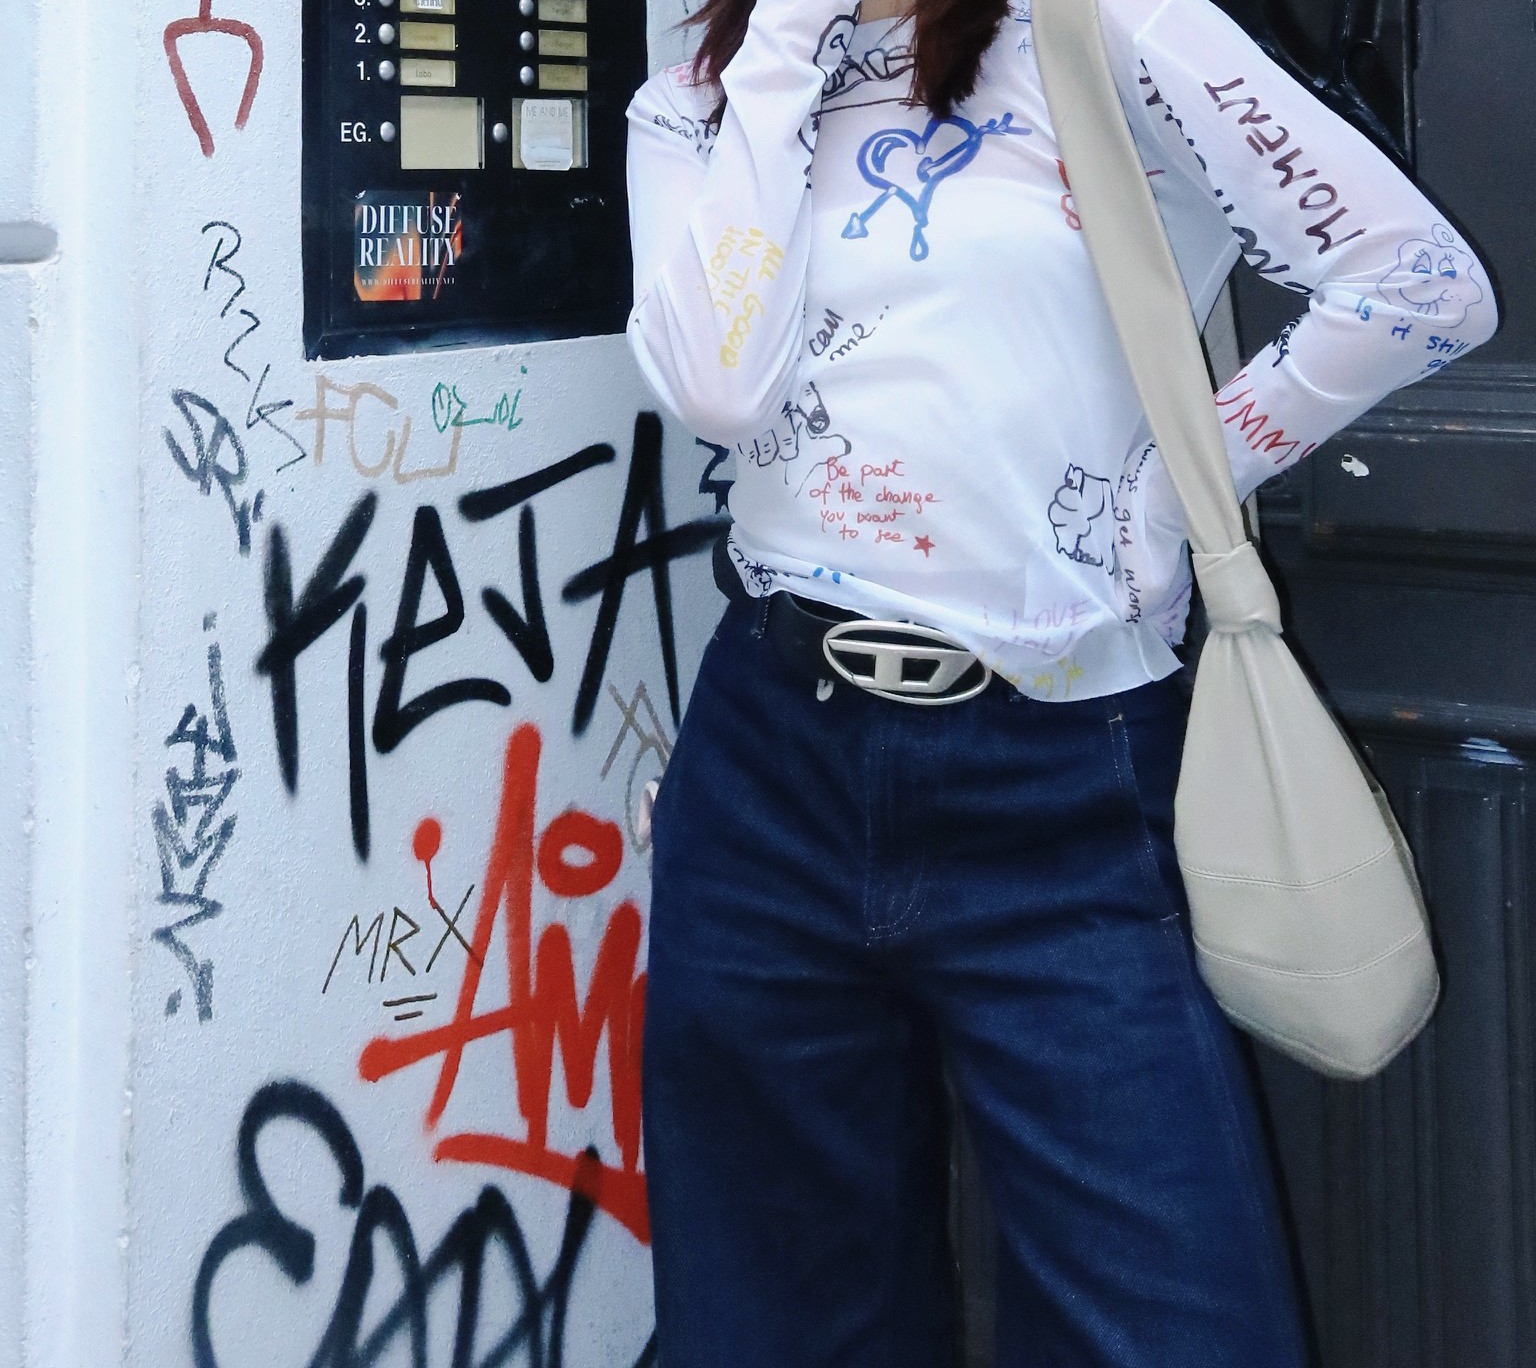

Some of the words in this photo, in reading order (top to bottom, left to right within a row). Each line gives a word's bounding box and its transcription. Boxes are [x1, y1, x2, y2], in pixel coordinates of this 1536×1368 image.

[354, 22, 371, 44] 2.
[356, 60, 371, 81] 1.
[340, 122, 372, 143] EG.
[1204, 77, 1367, 255] MOMENT
[360, 204, 457, 234] DIFFUSE
[359, 237, 456, 267] REALITY
[1391, 317, 1413, 341] it
[826, 456, 850, 481] Be
[860, 459, 905, 486] part
[809, 481, 831, 505] of
[839, 482, 864, 503] the
[875, 485, 943, 514] change
[838, 523, 859, 541] to
